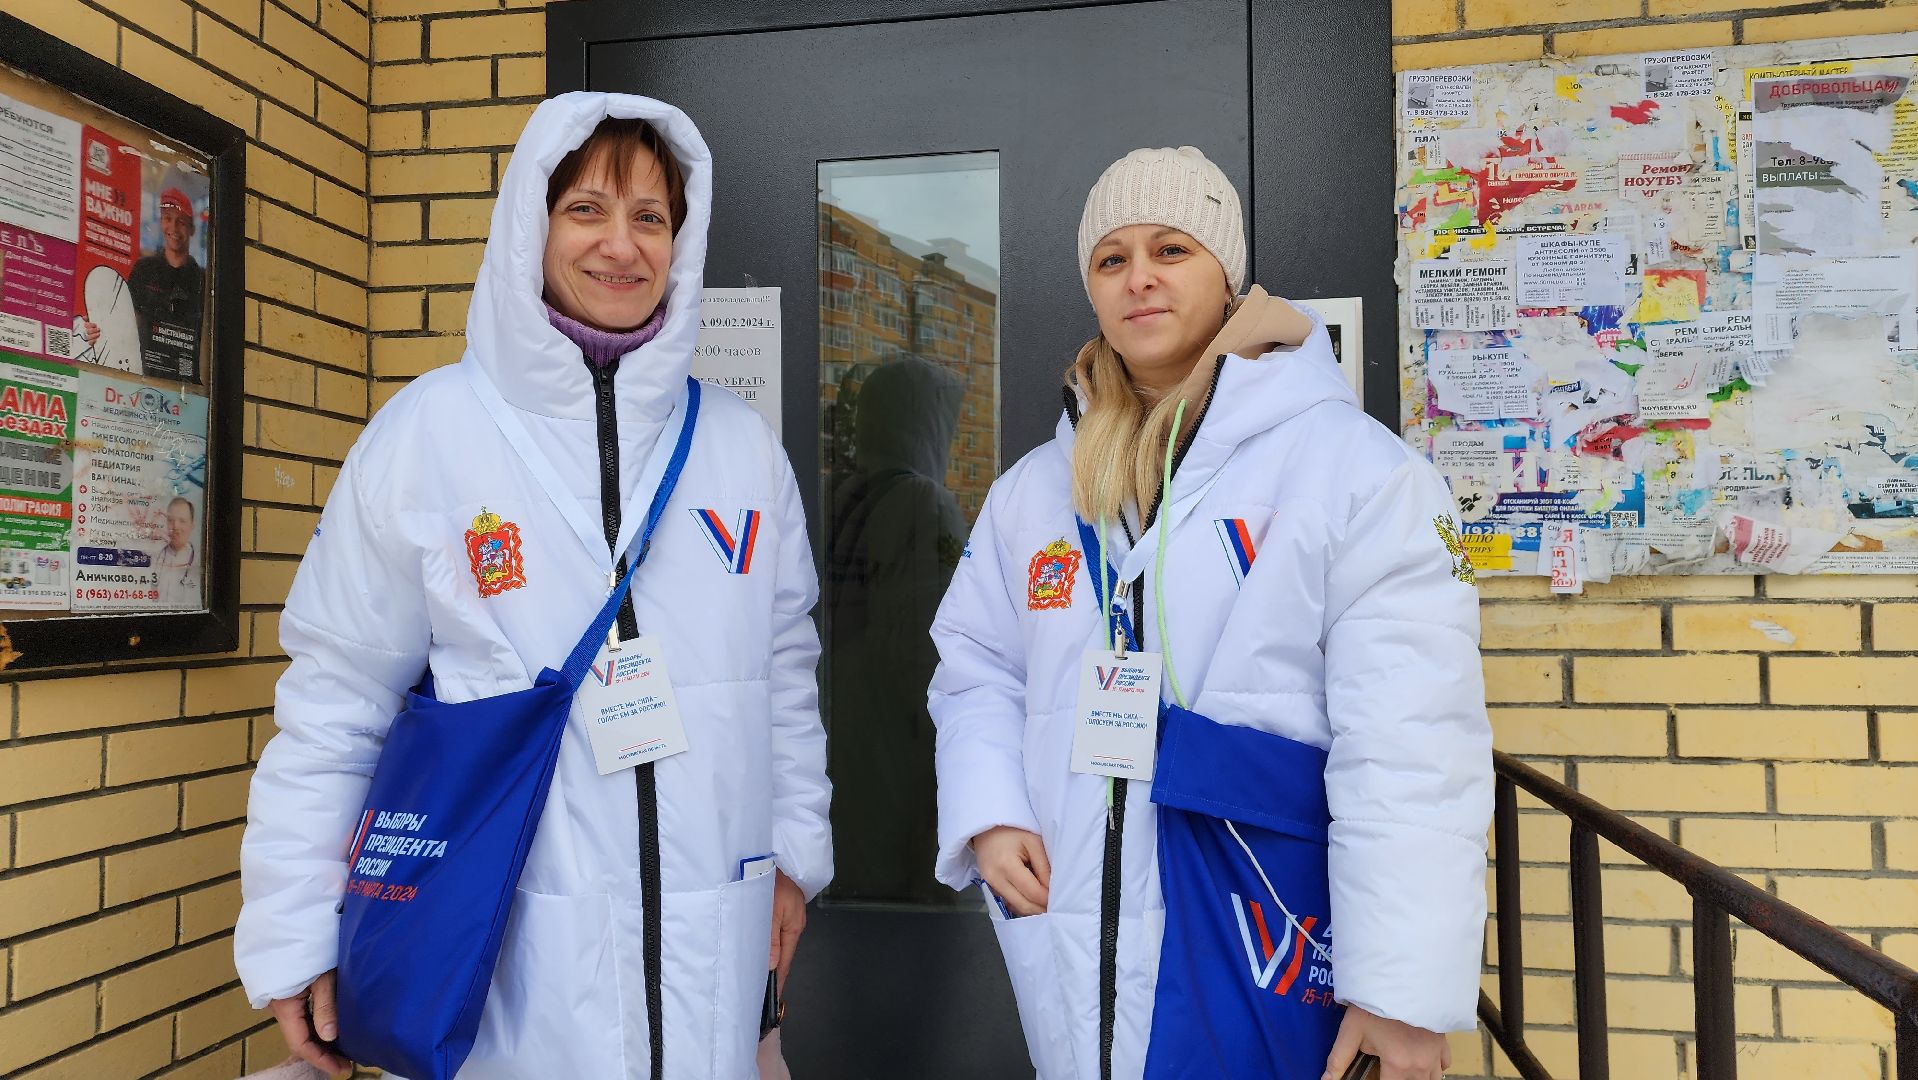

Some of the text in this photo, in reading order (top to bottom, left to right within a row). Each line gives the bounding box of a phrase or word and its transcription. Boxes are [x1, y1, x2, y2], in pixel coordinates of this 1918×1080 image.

[1644, 54, 1711, 65] ГРУЗОПЕРЕВОЗКИ
[1408, 75, 1472, 83] ГРУЗОПЕРЕВОЗКИ
[1762, 171, 1818, 183] ВЫПЛАТЫ
[86, 196, 132, 227] ВАЖНО
[1540, 239, 1600, 248] ШКАФЫ-КУПЕ
[1419, 267, 1508, 278] МЕЛКИЙ РЕМОНТ
[710, 317, 764, 328] 09.02.2024
[724, 346, 762, 357] часов
[1654, 350, 1684, 360] ВЕРЕЙ
[724, 376, 766, 386] УБРАТЬ
[0, 386, 67, 422] АМА
[1452, 440, 1484, 448] ПРОДАМ
[91, 458, 142, 473] ПЕДИАТРИЯ
[76, 569, 138, 585] Аничково,
[151, 572, 158, 584] 3
[76, 588, 160, 601] 8 (963) 621-68-89
[374, 810, 428, 832] ВЫБОРЫ
[363, 833, 448, 858] ПРЕЗИДЕНТА
[354, 856, 392, 878] РОССИИ
[380, 882, 418, 902] 2024
